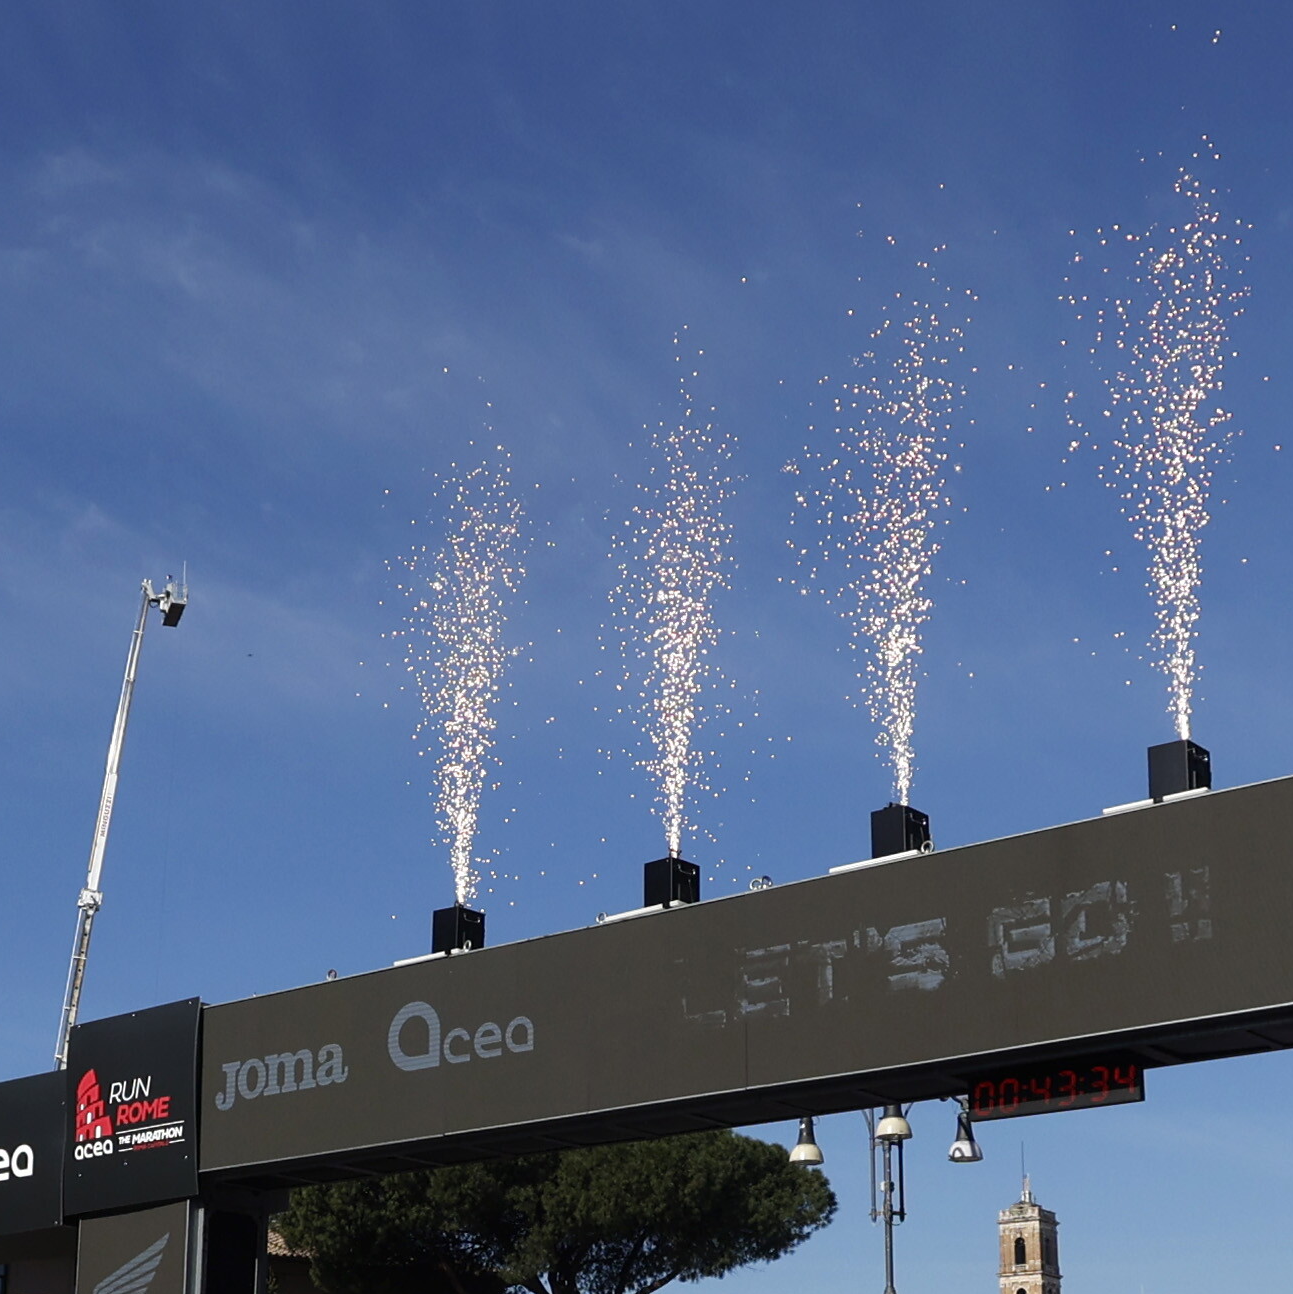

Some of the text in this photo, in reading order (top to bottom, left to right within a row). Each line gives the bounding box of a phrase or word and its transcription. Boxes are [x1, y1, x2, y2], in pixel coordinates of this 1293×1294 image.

[109, 1075, 151, 1104] RUN
[974, 1064, 1137, 1117] 00:43:34
[117, 1096, 172, 1126] ROME
[74, 1139, 113, 1160] acea
[118, 1126, 184, 1145] THE MARATHON
